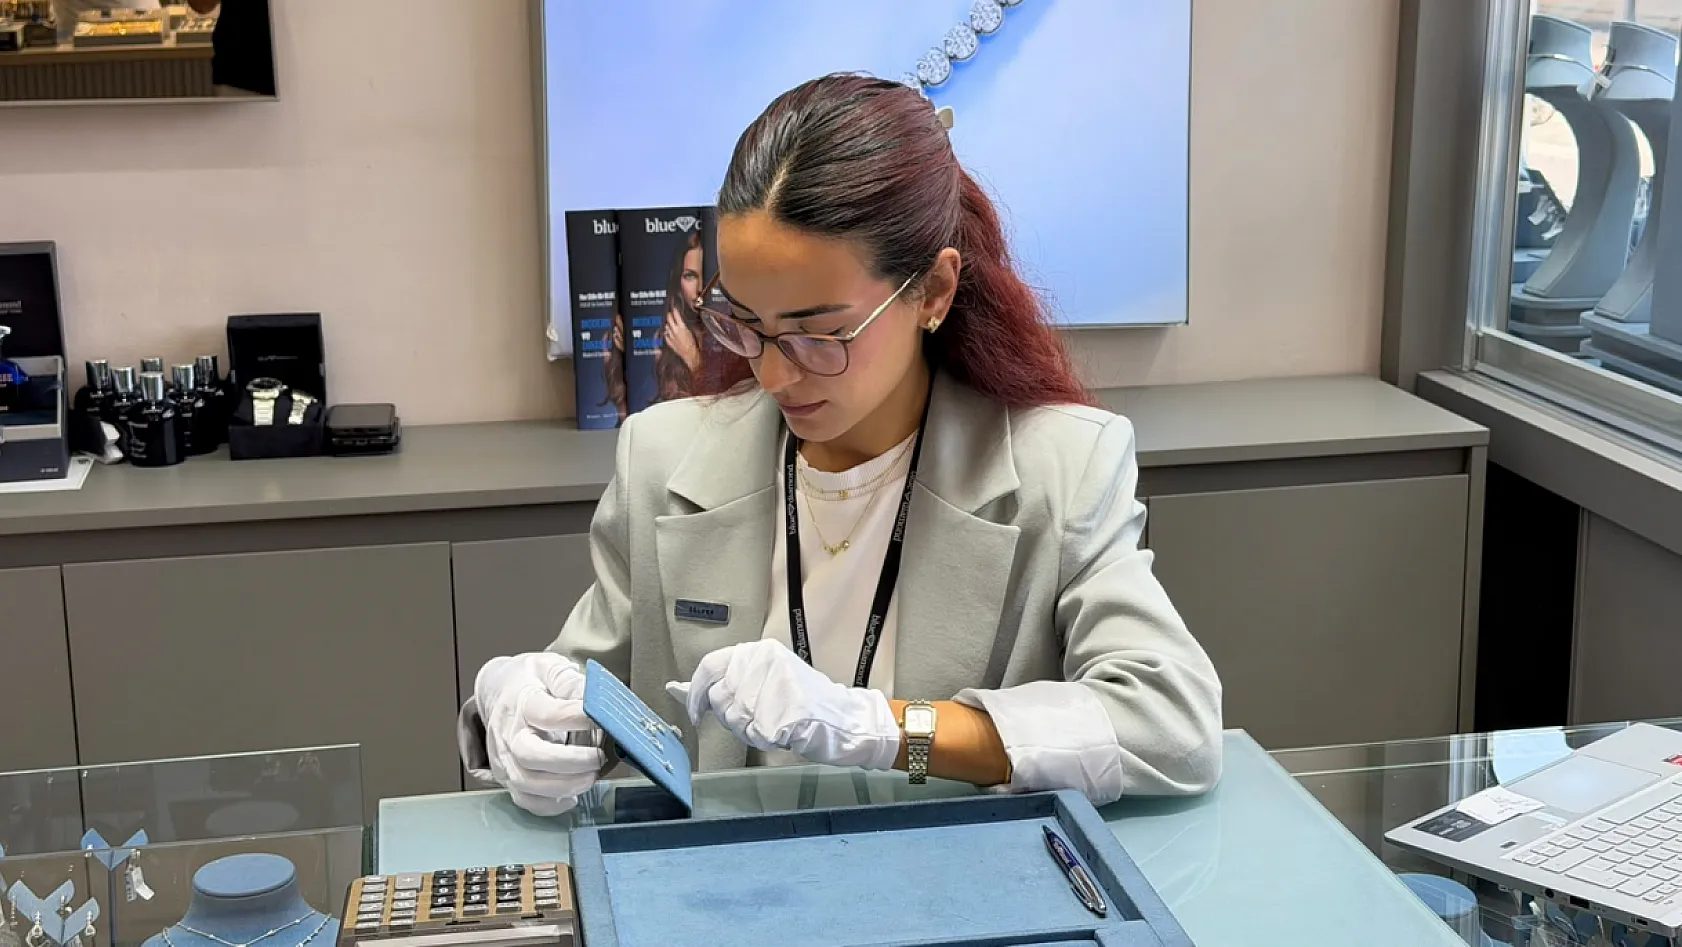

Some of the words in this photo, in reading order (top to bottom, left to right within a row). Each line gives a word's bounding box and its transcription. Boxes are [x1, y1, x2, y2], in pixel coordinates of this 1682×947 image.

[645, 217, 677, 233] blue
[786, 464, 794, 503] diamond
[793, 608, 806, 648] diamond
